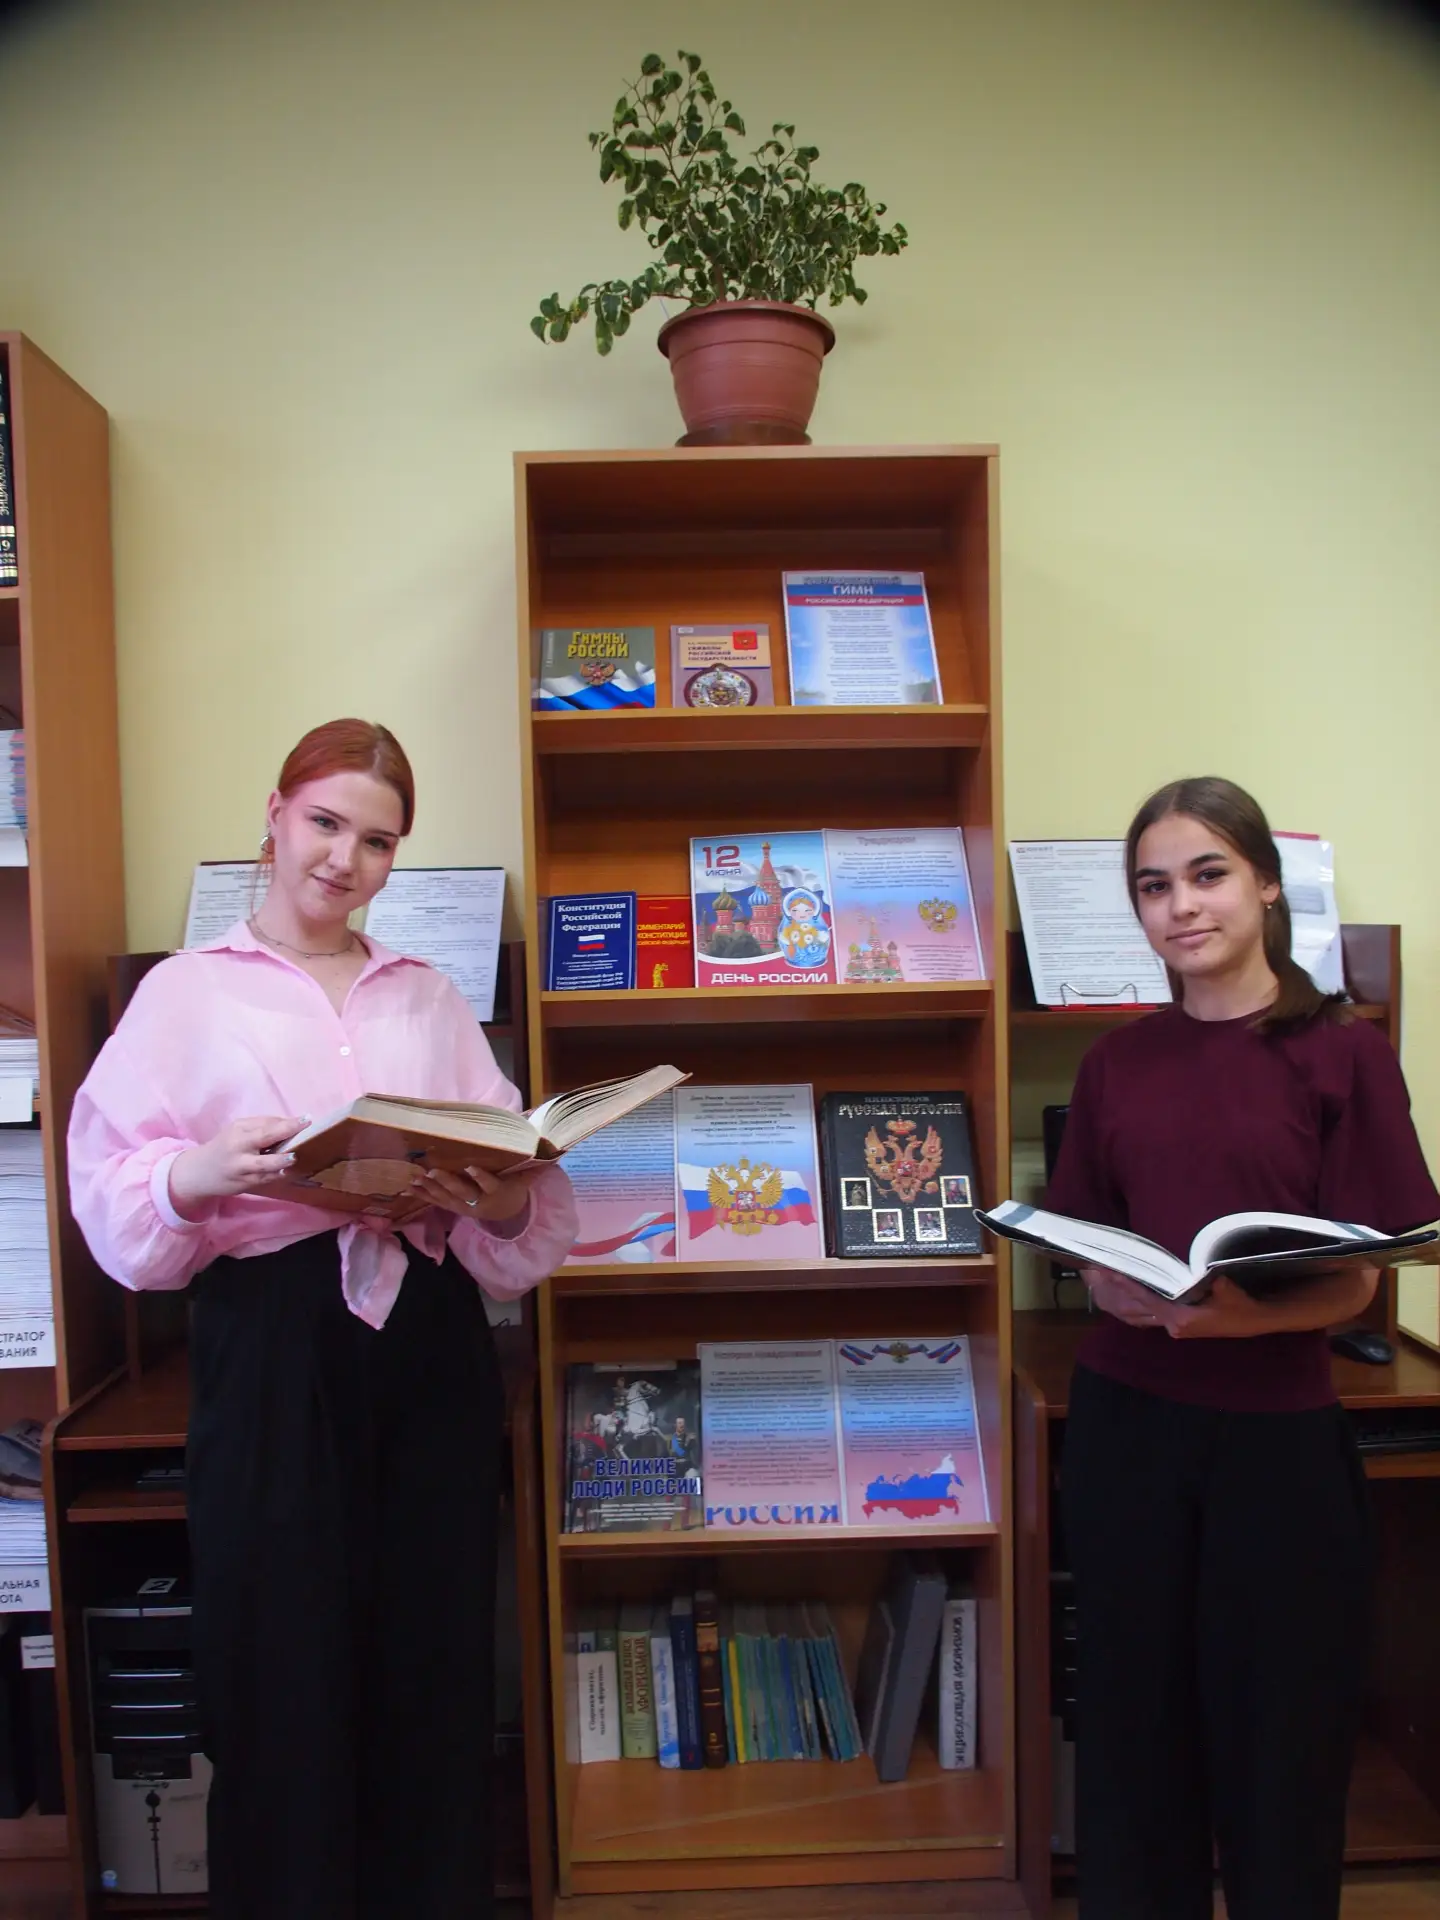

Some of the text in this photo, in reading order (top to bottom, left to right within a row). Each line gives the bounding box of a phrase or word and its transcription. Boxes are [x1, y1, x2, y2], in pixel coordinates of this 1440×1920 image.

[832, 585, 874, 595] ГИМН
[567, 643, 629, 658] РОССИИ
[702, 845, 741, 868] 12
[705, 868, 741, 876] ИЮНЯ
[558, 902, 626, 912] Конституция
[561, 912, 622, 922] Российской
[562, 922, 621, 932] Федерации
[711, 972, 828, 984] ДЕНЬ РОССИИ
[596, 1458, 676, 1476] ВЕЛИКИЕ
[573, 1477, 701, 1498] ЛЮДИ РОССИИ
[705, 1502, 839, 1525] РОССИЯ
[146, 1580, 170, 1590] 2
[634, 1636, 650, 1715] АФОРИЗМОВ
[952, 1616, 967, 1766] ЭНЦИКЛОПЕДИЯ АФОРИЗМОВ
